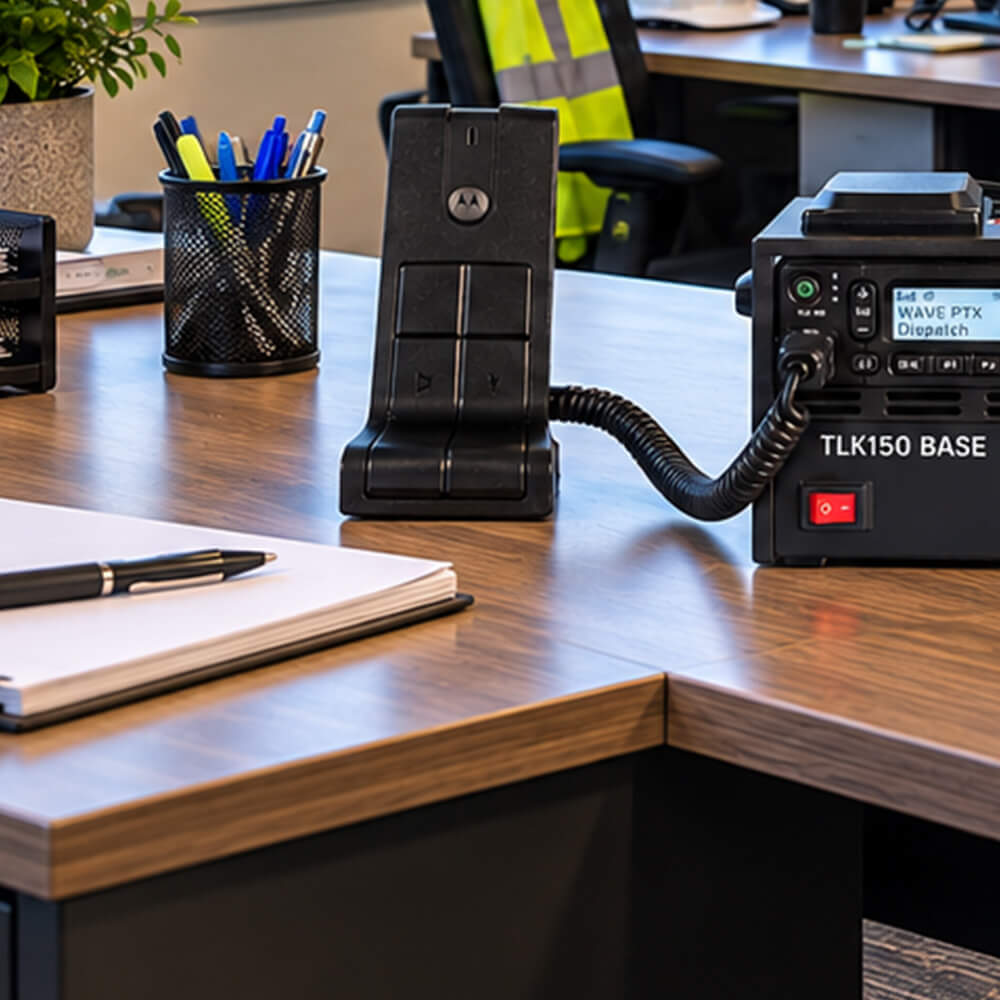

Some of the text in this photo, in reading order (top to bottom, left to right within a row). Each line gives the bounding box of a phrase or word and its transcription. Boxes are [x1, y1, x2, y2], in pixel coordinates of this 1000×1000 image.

[898, 306, 983, 320] WAVE PTX
[820, 434, 987, 458] TLK150 BASE
